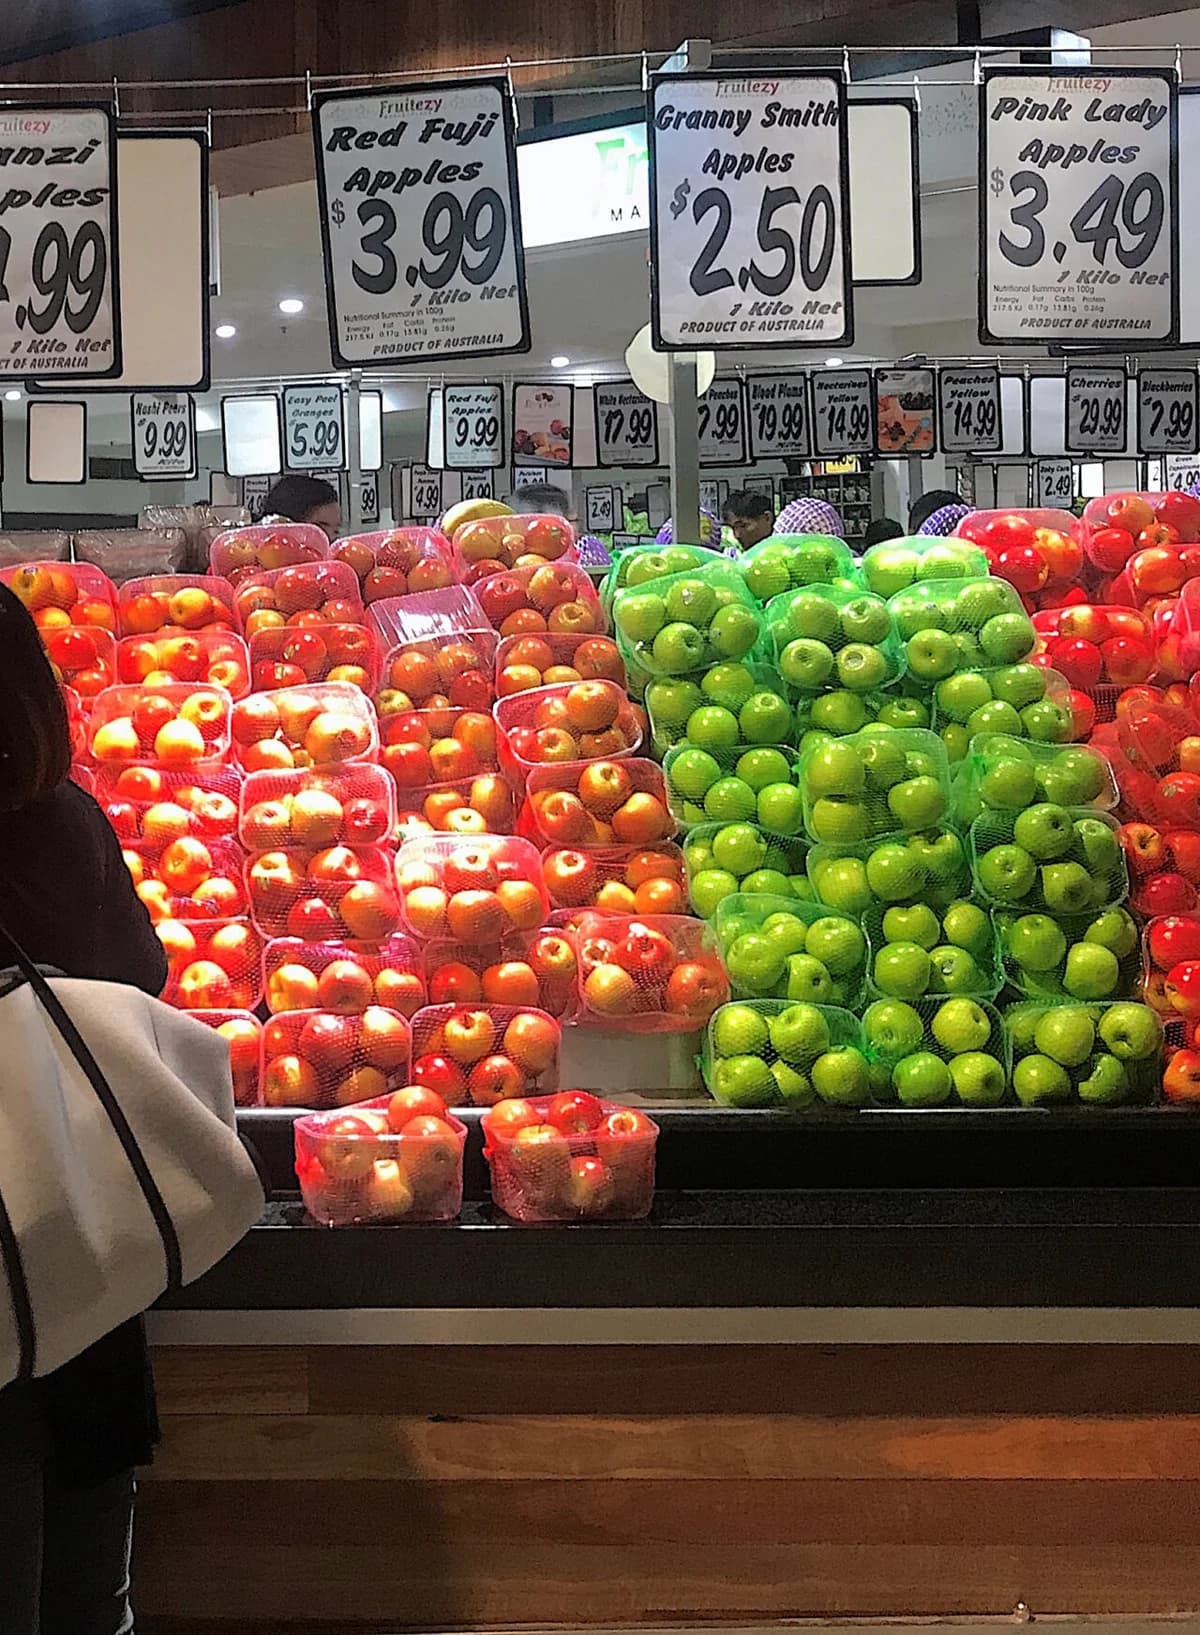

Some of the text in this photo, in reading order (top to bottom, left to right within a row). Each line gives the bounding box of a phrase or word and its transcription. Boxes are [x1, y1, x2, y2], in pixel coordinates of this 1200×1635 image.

[716, 80, 780, 97] Fruitezy
[1048, 78, 1112, 93] Fruitezy
[379, 98, 443, 118] Fruitezy
[990, 97, 1168, 130] Pink Lady
[656, 100, 839, 137] Granny Smith
[326, 113, 499, 152] Red Fuji
[1018, 138, 1140, 169] Apples
[702, 146, 795, 181] Apples
[343, 159, 483, 197] Apples
[1056, 270, 1170, 285] 1 Kilo Net
[410, 285, 516, 307] 1 Kilo Net
[993, 285, 1095, 294] Nutritional Summary in 100g
[344, 312, 379, 322] Nutritional
[381, 309, 415, 320] Summary
[425, 306, 444, 316] 100g
[729, 301, 843, 316] 1 Kilo Net
[680, 319, 824, 333] PRODUCT OF AUSTRALIA
[1020, 317, 1151, 329] PRODUCT OF AUSTRALIA
[10, 338, 111, 354] 1 Kilo Net
[373, 334, 504, 355] PRODUCT OF AUSTRALIA
[13, 358, 27, 369] OF
[29, 356, 89, 369] AUSTRALIA
[816, 380, 868, 390] Nectarines
[944, 375, 995, 385] Peaches
[1070, 377, 1122, 389] Cherries
[1142, 380, 1193, 392] Blackberries
[288, 394, 337, 406] Easy Peel
[448, 394, 498, 404] Red Fuji
[827, 394, 859, 404] Yellow
[950, 389, 990, 398] Yellow
[136, 401, 186, 415] Nashi Pears
[292, 409, 334, 418] Oranges
[451, 406, 493, 416] Apples
